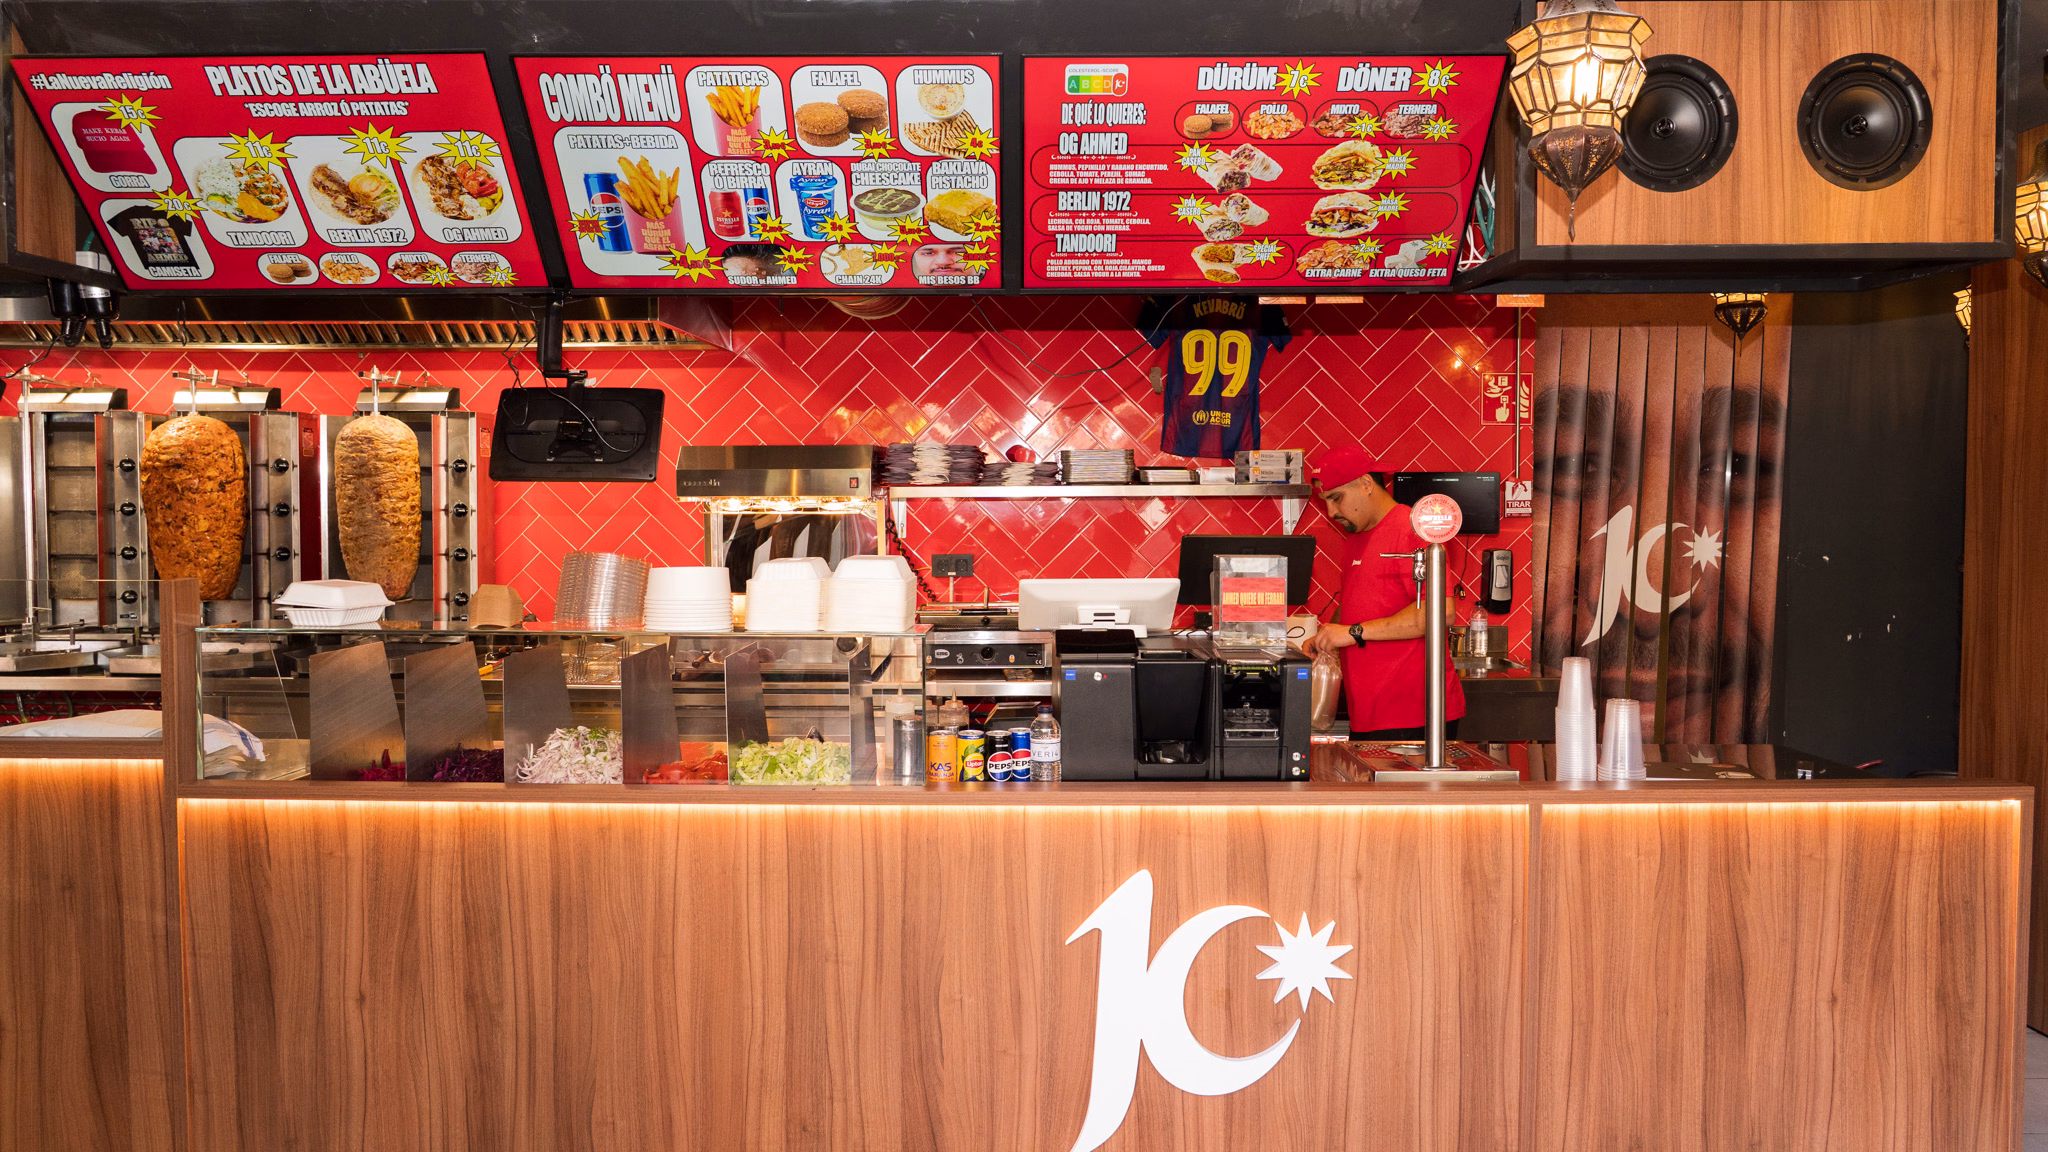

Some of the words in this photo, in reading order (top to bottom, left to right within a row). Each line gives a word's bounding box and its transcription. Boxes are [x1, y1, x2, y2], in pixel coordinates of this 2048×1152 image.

[30, 72, 172, 92] #LaNuevaReligión
[203, 63, 294, 96] PLATOS
[288, 63, 326, 96] DE
[324, 62, 354, 95] LA
[350, 58, 438, 95] ABÜELA
[697, 71, 769, 86] PATATICAS
[811, 71, 861, 86] FALAFEL
[913, 69, 974, 84] HUMMUS
[1197, 62, 1278, 91] DÜRÜM
[1336, 63, 1412, 92] DÖNER
[538, 64, 621, 122] COMBÖ
[617, 64, 682, 122] MENÜ
[299, 101, 341, 117] ARROZ
[1061, 103, 1074, 125] DE
[1075, 99, 1093, 127] QUÉ
[1093, 103, 1105, 125] LO
[1106, 103, 1147, 127] QUIERES:
[1195, 104, 1230, 114] FALAFEL
[1260, 104, 1288, 114] POLLO
[1330, 104, 1360, 115] MIXTO
[1399, 104, 1438, 114] TERNERA
[1059, 132, 1079, 155] OG
[1080, 132, 1128, 155] AHMED
[1189, 148, 1201, 157] PAN
[851, 162, 876, 172] DUBAI
[877, 162, 921, 172] CHOCOLATE
[1181, 157, 1207, 166] CASERO
[708, 162, 771, 177] REFRESCO
[792, 162, 834, 176] AYRAN
[932, 161, 988, 176] BAKLAVA
[109, 174, 150, 188] GORRA
[727, 175, 768, 189] BIRRA
[852, 172, 922, 186] CHEESCAKE
[931, 175, 988, 189] PISTACHO
[1058, 191, 1101, 211] BERLIN
[1101, 190, 1132, 211] 1972
[1184, 199, 1196, 207] PAN
[1177, 207, 1202, 216] CASERO
[130, 218, 157, 229] RIP
[227, 231, 296, 246] TANDOORI
[327, 228, 375, 243] BERLIN
[374, 228, 408, 243] 1972
[443, 227, 464, 242] OG
[463, 227, 508, 242] AHMED
[1055, 233, 1117, 253] TANDOORI
[1253, 244, 1277, 253] SPECIAL
[147, 253, 188, 263] AHMED
[268, 254, 301, 264] FALAFEL
[332, 253, 359, 263] POLLO
[401, 253, 429, 263] MIXTO
[459, 253, 499, 263] TERNERA
[1255, 252, 1271, 261] CHEF
[148, 266, 202, 278] CAMISETA
[1305, 268, 1334, 278] EXTRA
[1333, 268, 1363, 278] CARNE
[1369, 268, 1398, 278] EXTRA
[1397, 268, 1426, 279] QUESO
[1426, 268, 1448, 278] FETA
[728, 275, 759, 285] SUDOR
[766, 275, 798, 285] AHMED
[835, 275, 864, 285] CHAIN
[864, 275, 882, 285] 24K
[918, 275, 936, 285] MIS
[936, 275, 965, 285] BESOS
[966, 275, 980, 285] BB
[1193, 298, 1247, 320] KEVABRÖ
[1182, 329, 1252, 397] 99
[930, 761, 952, 771] KAS
[966, 761, 983, 769] Lipton
[989, 762, 1012, 770] PEPS
